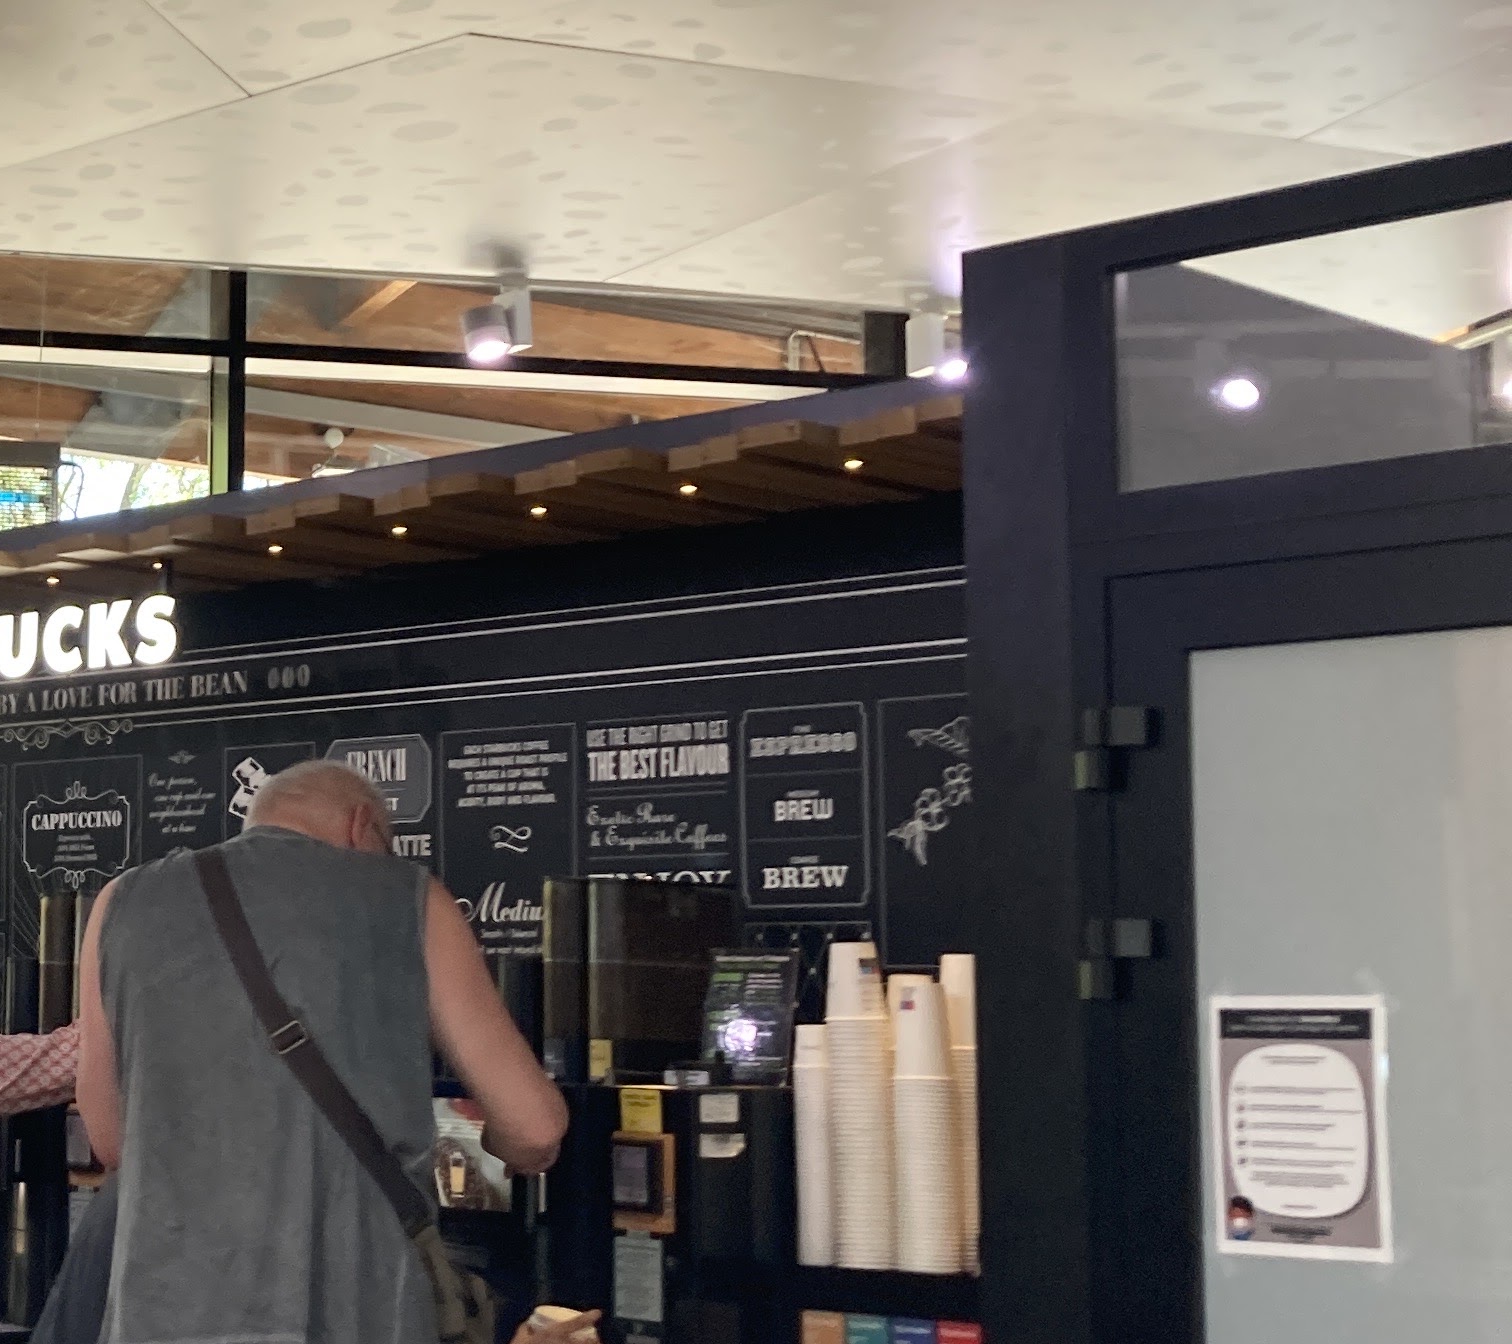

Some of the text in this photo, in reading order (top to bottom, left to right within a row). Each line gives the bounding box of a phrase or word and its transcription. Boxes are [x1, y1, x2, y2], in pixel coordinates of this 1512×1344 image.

[23, 691, 37, 713] A
[42, 685, 92, 711] LOVE
[98, 681, 137, 707] FOR
[143, 676, 184, 702] THE
[191, 670, 248, 698] BEAN
[587, 742, 730, 782] THE BEST FLAVOUR
[31, 810, 123, 831] CAPPUCCINO
[774, 797, 834, 822] BREW
[392, 833, 432, 856] ATTE
[762, 865, 849, 889] BREW
[454, 881, 544, 923] Mediu
